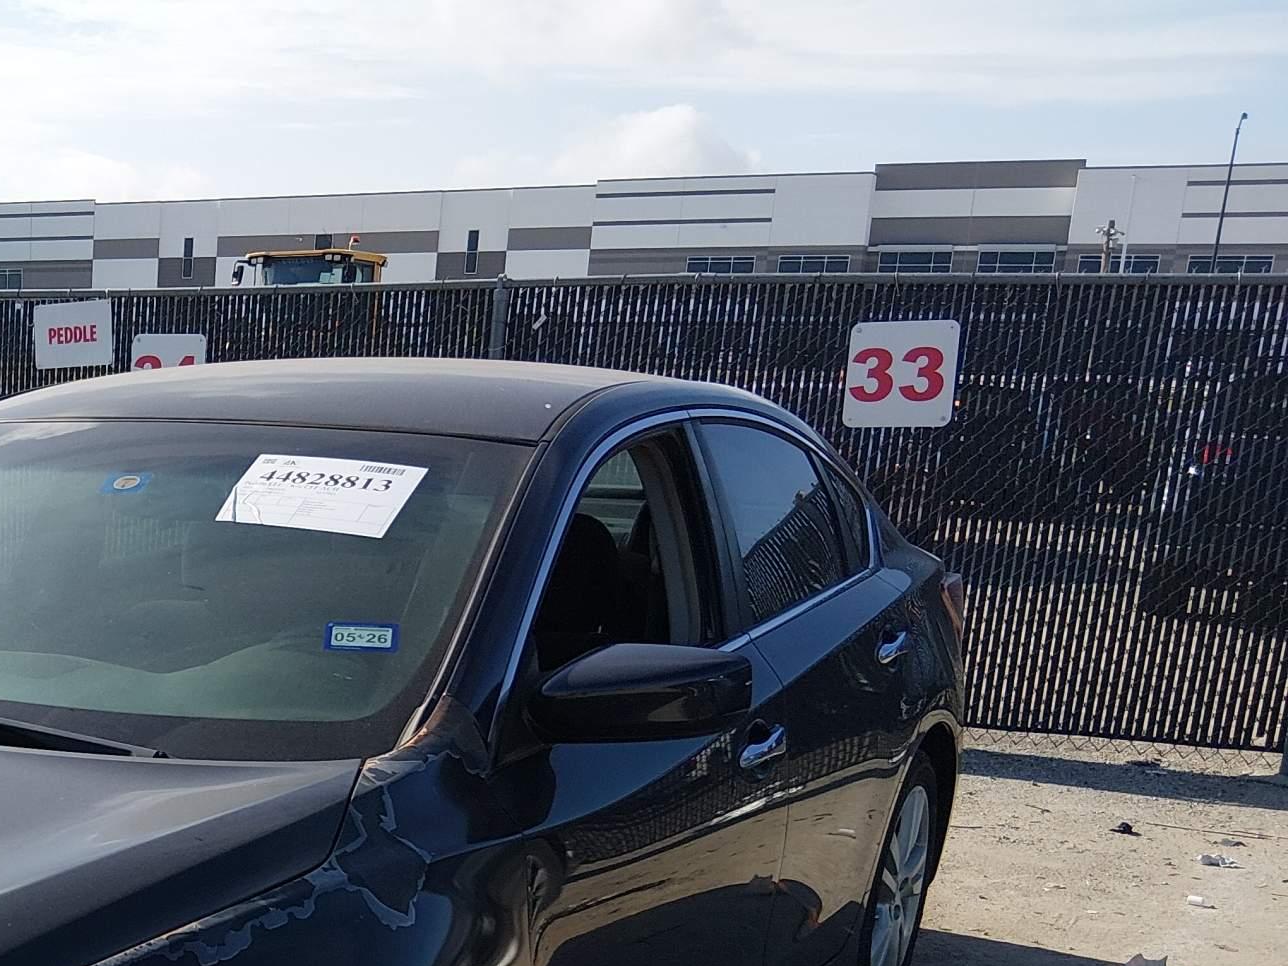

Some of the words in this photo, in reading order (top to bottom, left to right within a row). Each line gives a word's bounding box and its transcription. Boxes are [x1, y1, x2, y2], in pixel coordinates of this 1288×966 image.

[48, 325, 97, 345] PEDDLE
[849, 346, 944, 402] 33
[259, 469, 394, 492] 44828813
